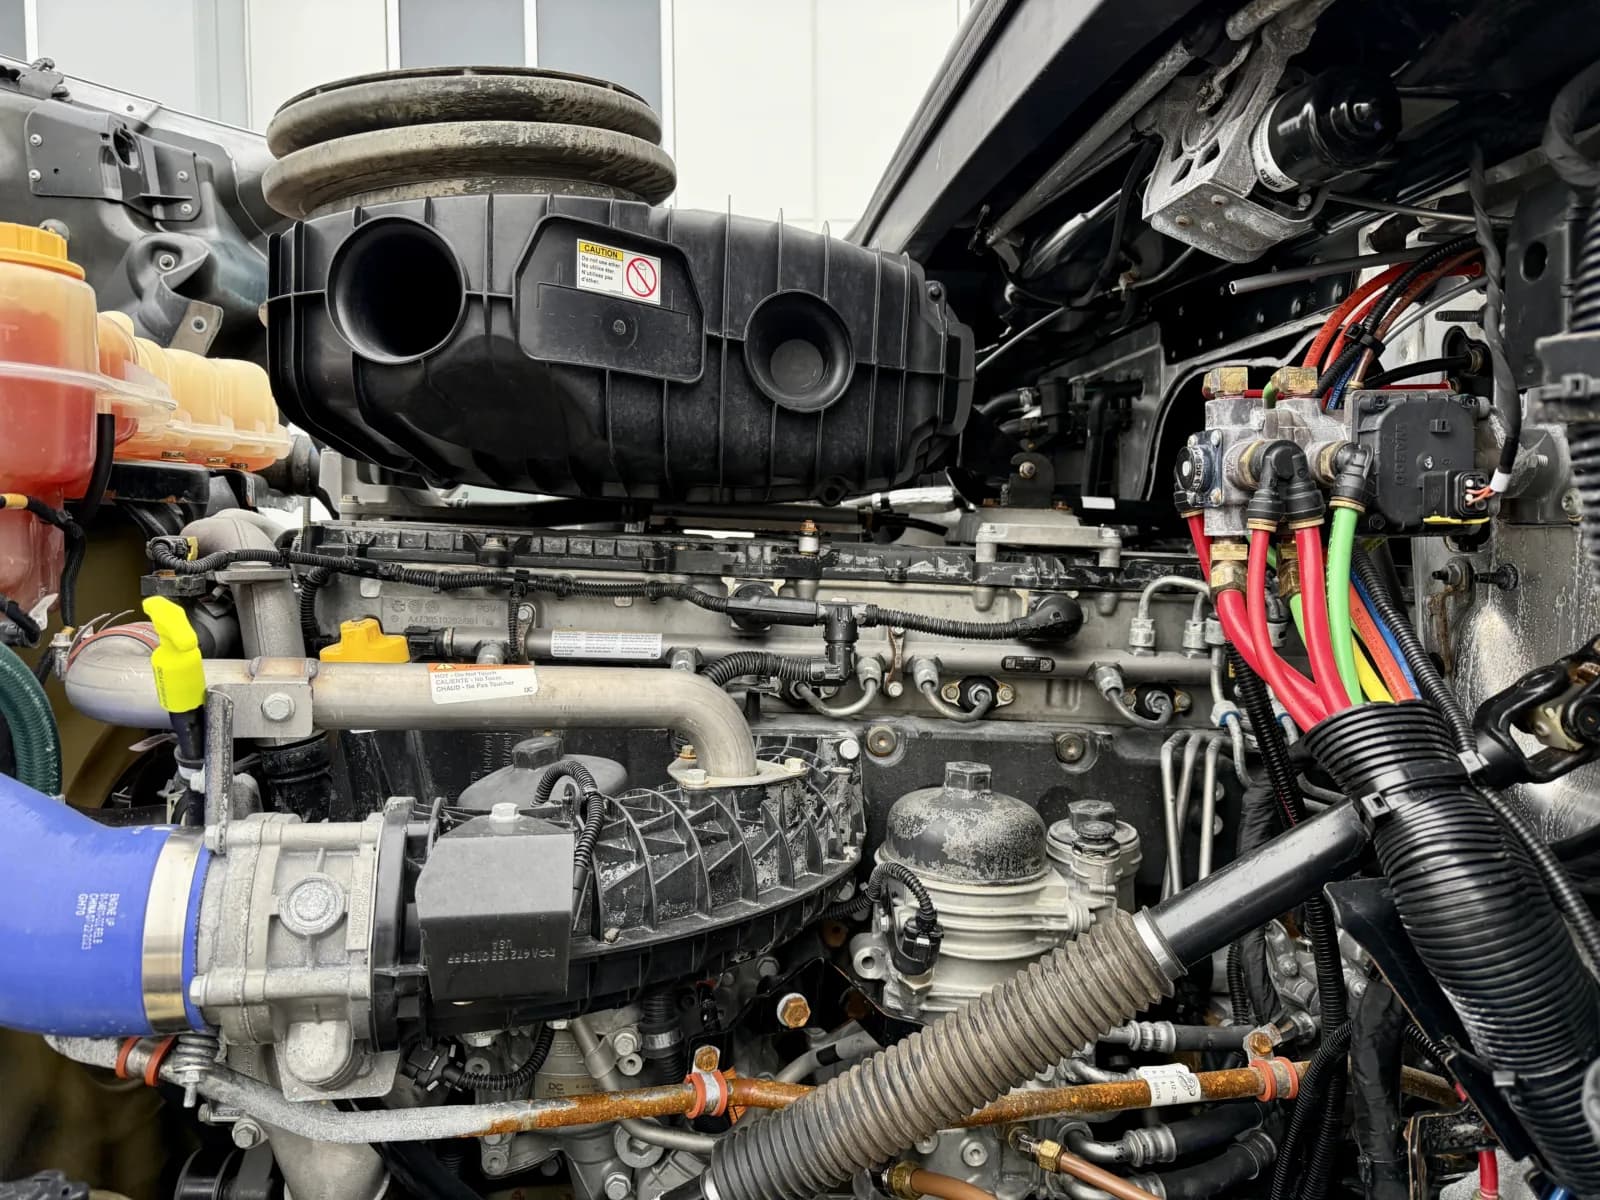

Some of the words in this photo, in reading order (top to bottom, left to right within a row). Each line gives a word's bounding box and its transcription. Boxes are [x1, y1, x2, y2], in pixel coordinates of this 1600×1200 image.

[1260, 168, 1281, 188] TRICO
[584, 244, 618, 258] CAUTION
[1393, 424, 1408, 487] WABCO
[436, 685, 461, 693] CHAUD
[75, 893, 89, 916] GH70
[87, 893, 99, 914] CHINA
[107, 893, 119, 916] ENGINE
